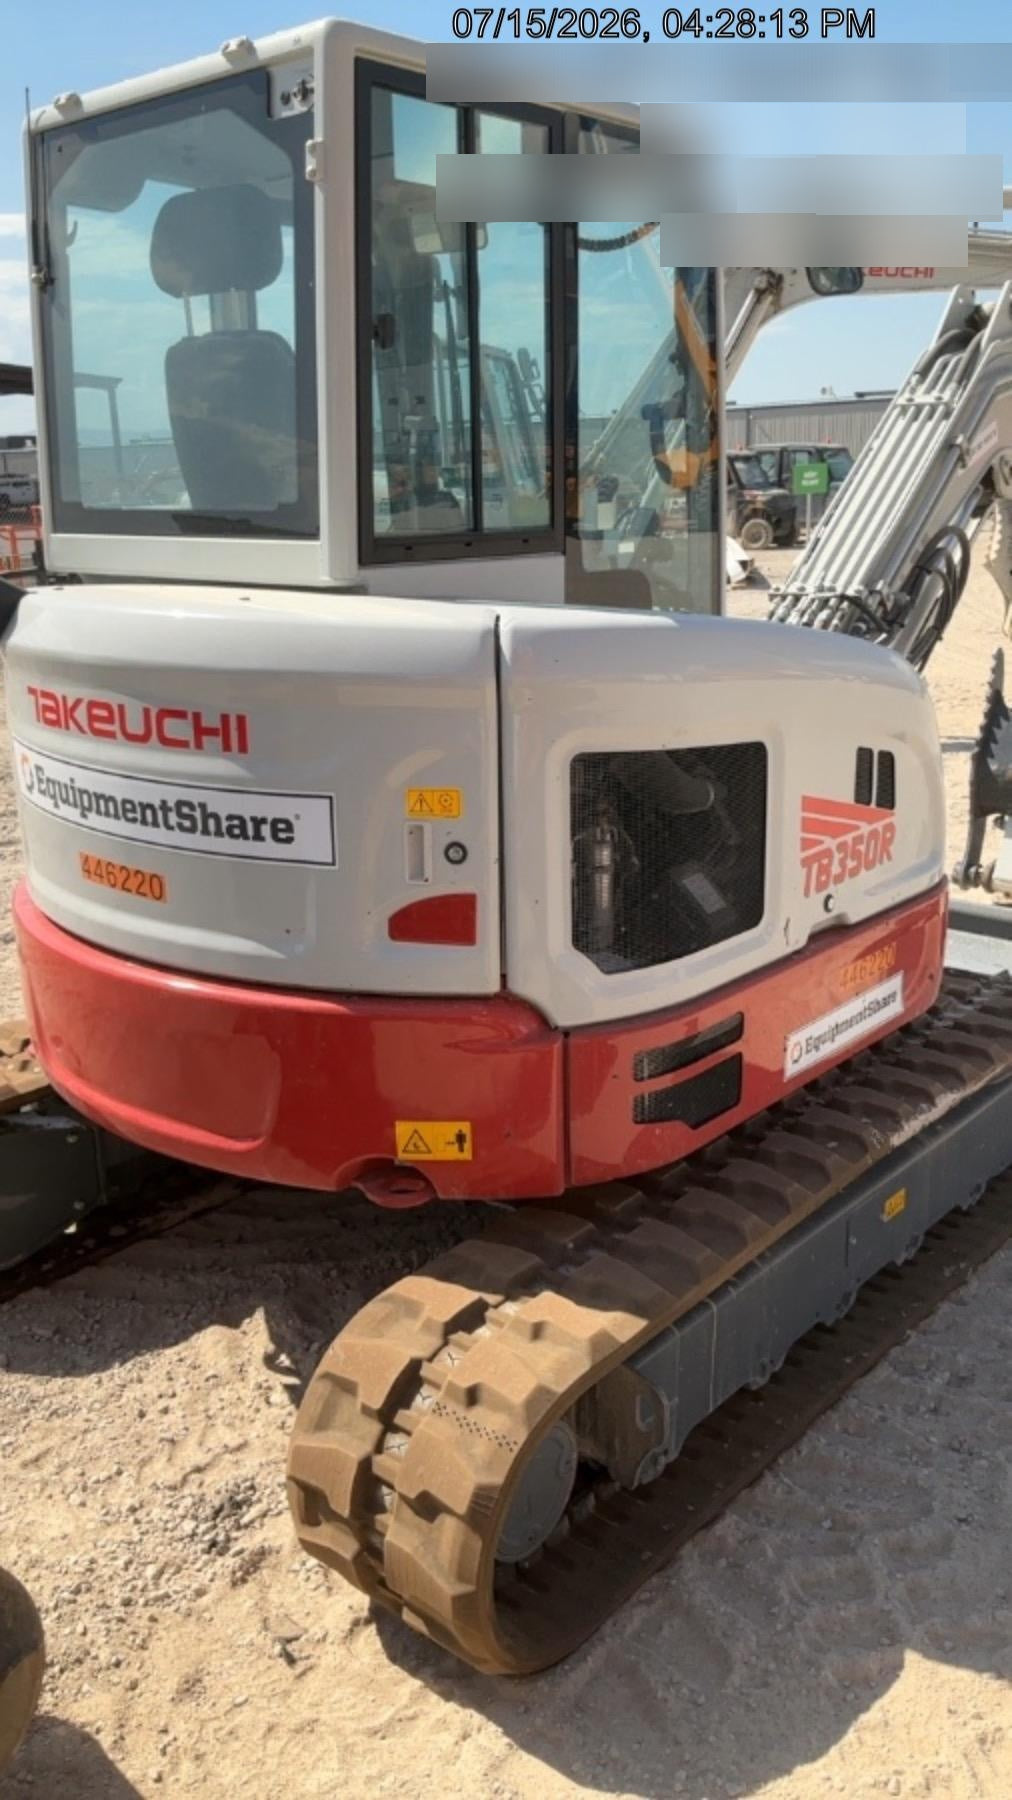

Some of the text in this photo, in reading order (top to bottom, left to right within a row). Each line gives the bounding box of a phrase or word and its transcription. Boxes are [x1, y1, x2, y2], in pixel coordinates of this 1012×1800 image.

[34, 767, 296, 844] EquipmentShare
[80, 853, 165, 901] 446220
[800, 821, 896, 897] TB350R
[805, 990, 897, 1054] EquipmentShare
